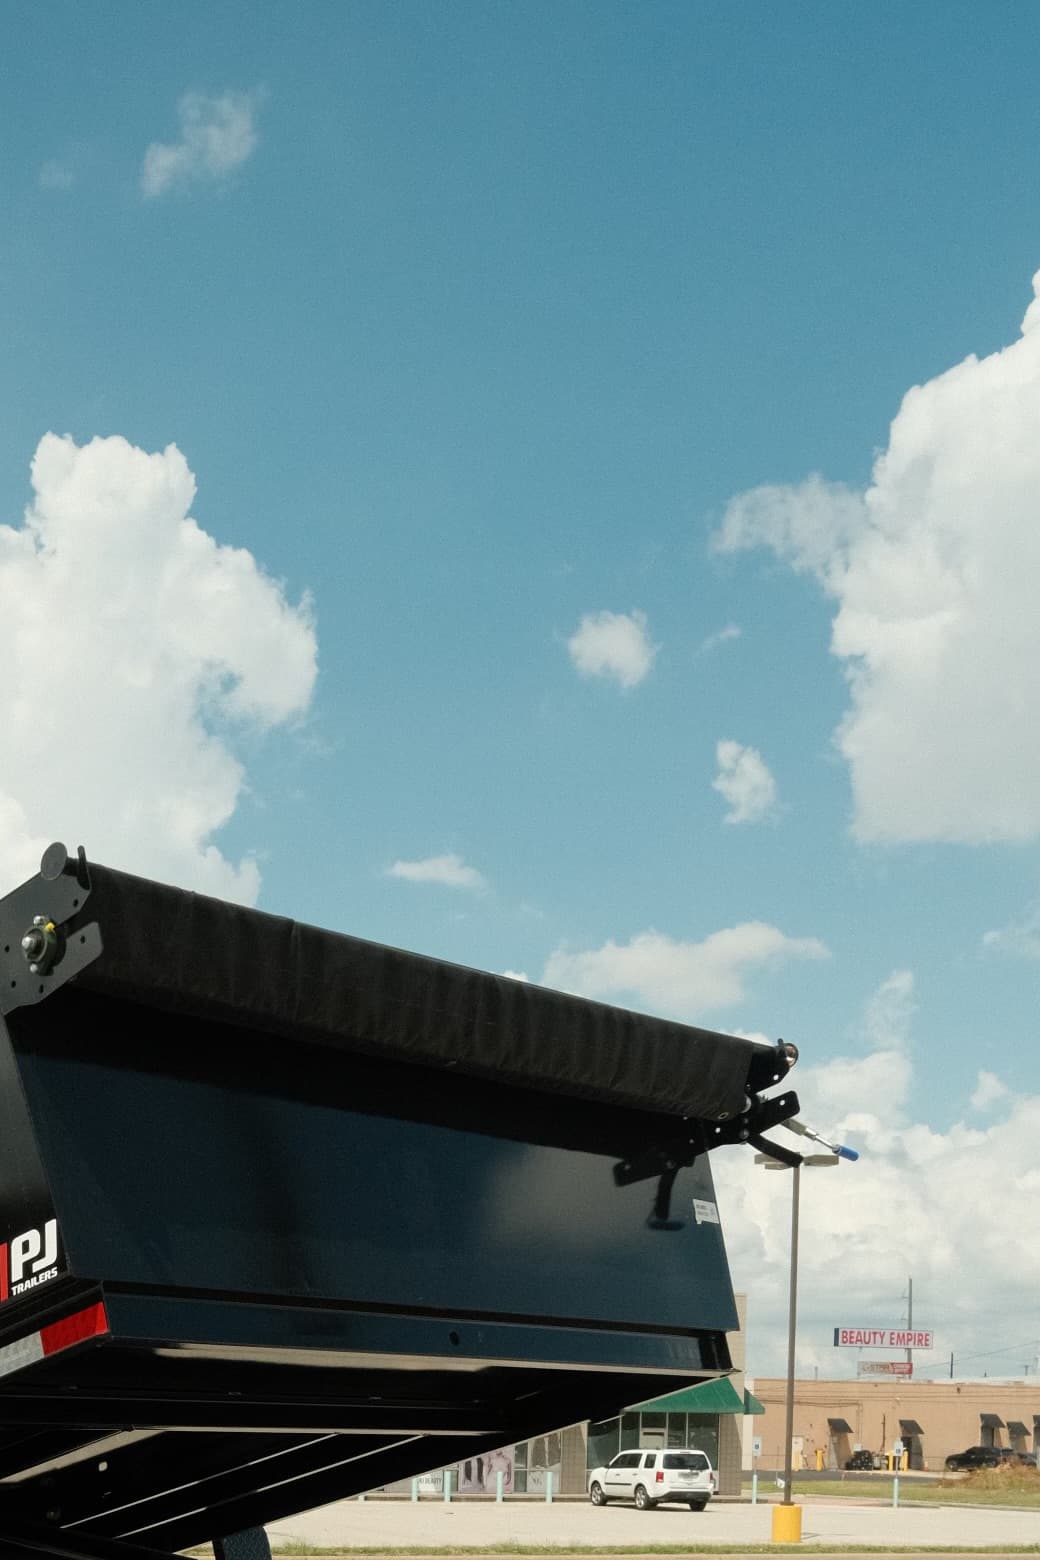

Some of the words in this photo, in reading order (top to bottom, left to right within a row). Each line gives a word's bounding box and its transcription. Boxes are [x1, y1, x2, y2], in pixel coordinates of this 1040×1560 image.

[10, 1218, 58, 1284] PJ
[11, 1266, 59, 1297] TRAILERS
[841, 1330, 886, 1345] BEAUTY
[889, 1331, 931, 1347] EMPIRE
